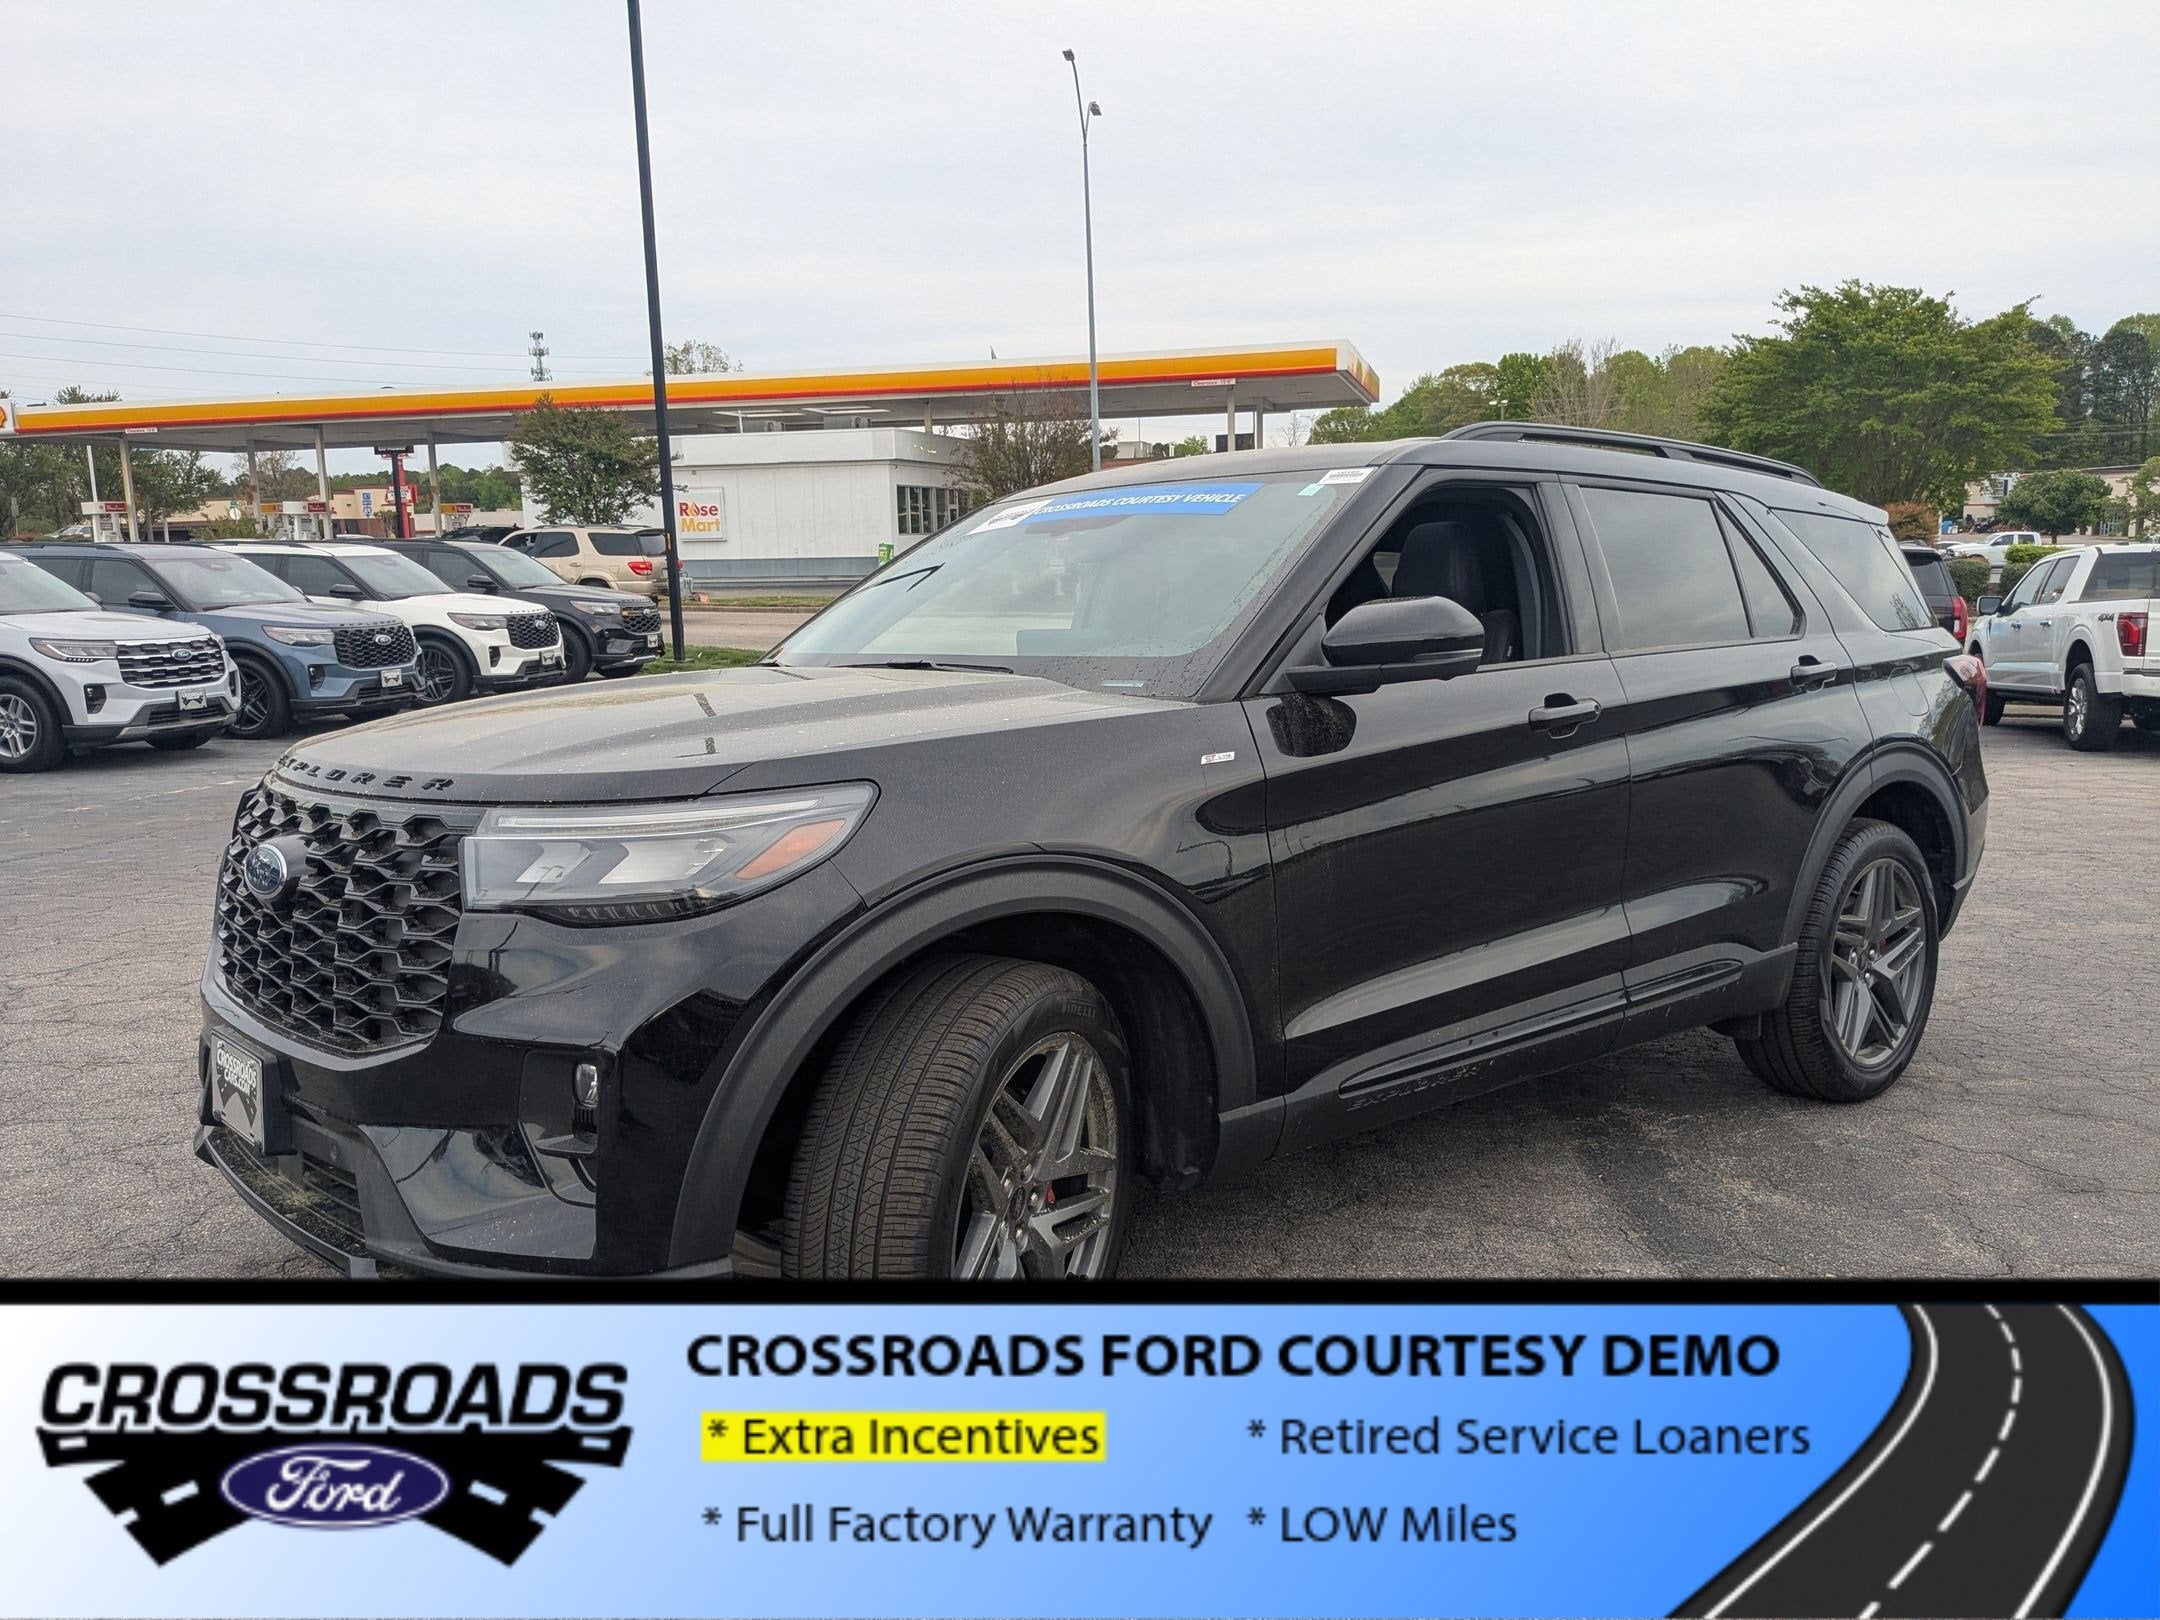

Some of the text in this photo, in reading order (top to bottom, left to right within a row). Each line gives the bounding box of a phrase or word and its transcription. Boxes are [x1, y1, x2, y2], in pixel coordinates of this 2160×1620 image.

[1111, 494, 1184, 506] COURTESY
[1183, 494, 1248, 504] VEHICLE
[679, 501, 719, 517] Rose
[681, 518, 721, 532] Mart
[217, 1048, 257, 1089] CROSSROADS
